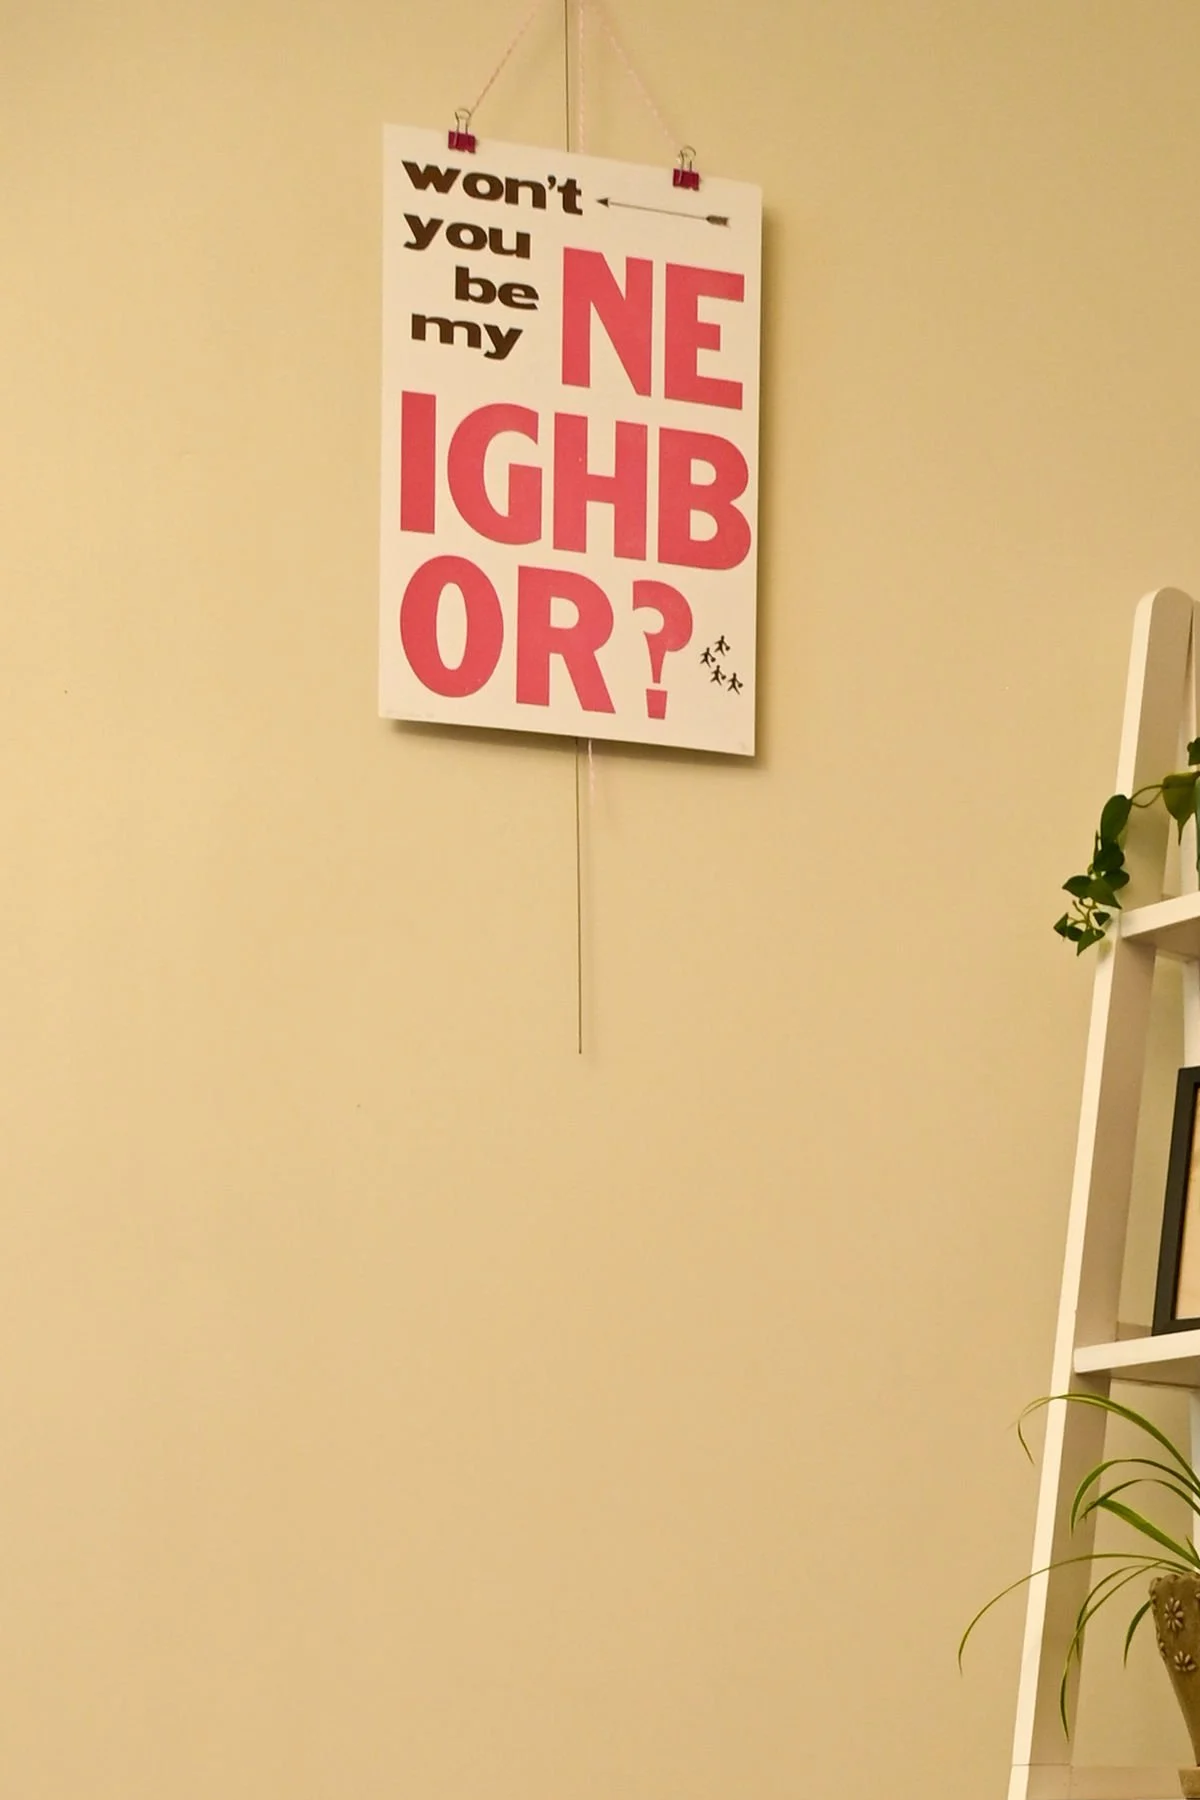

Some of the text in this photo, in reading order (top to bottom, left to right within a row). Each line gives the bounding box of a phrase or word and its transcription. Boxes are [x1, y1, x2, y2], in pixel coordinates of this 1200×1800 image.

[401, 159, 584, 216] won't
[402, 212, 531, 260] you
[454, 265, 539, 311] be
[410, 313, 524, 361] my
[562, 246, 745, 410] NE
[400, 390, 752, 571] IGHB
[400, 554, 694, 721] OR?
